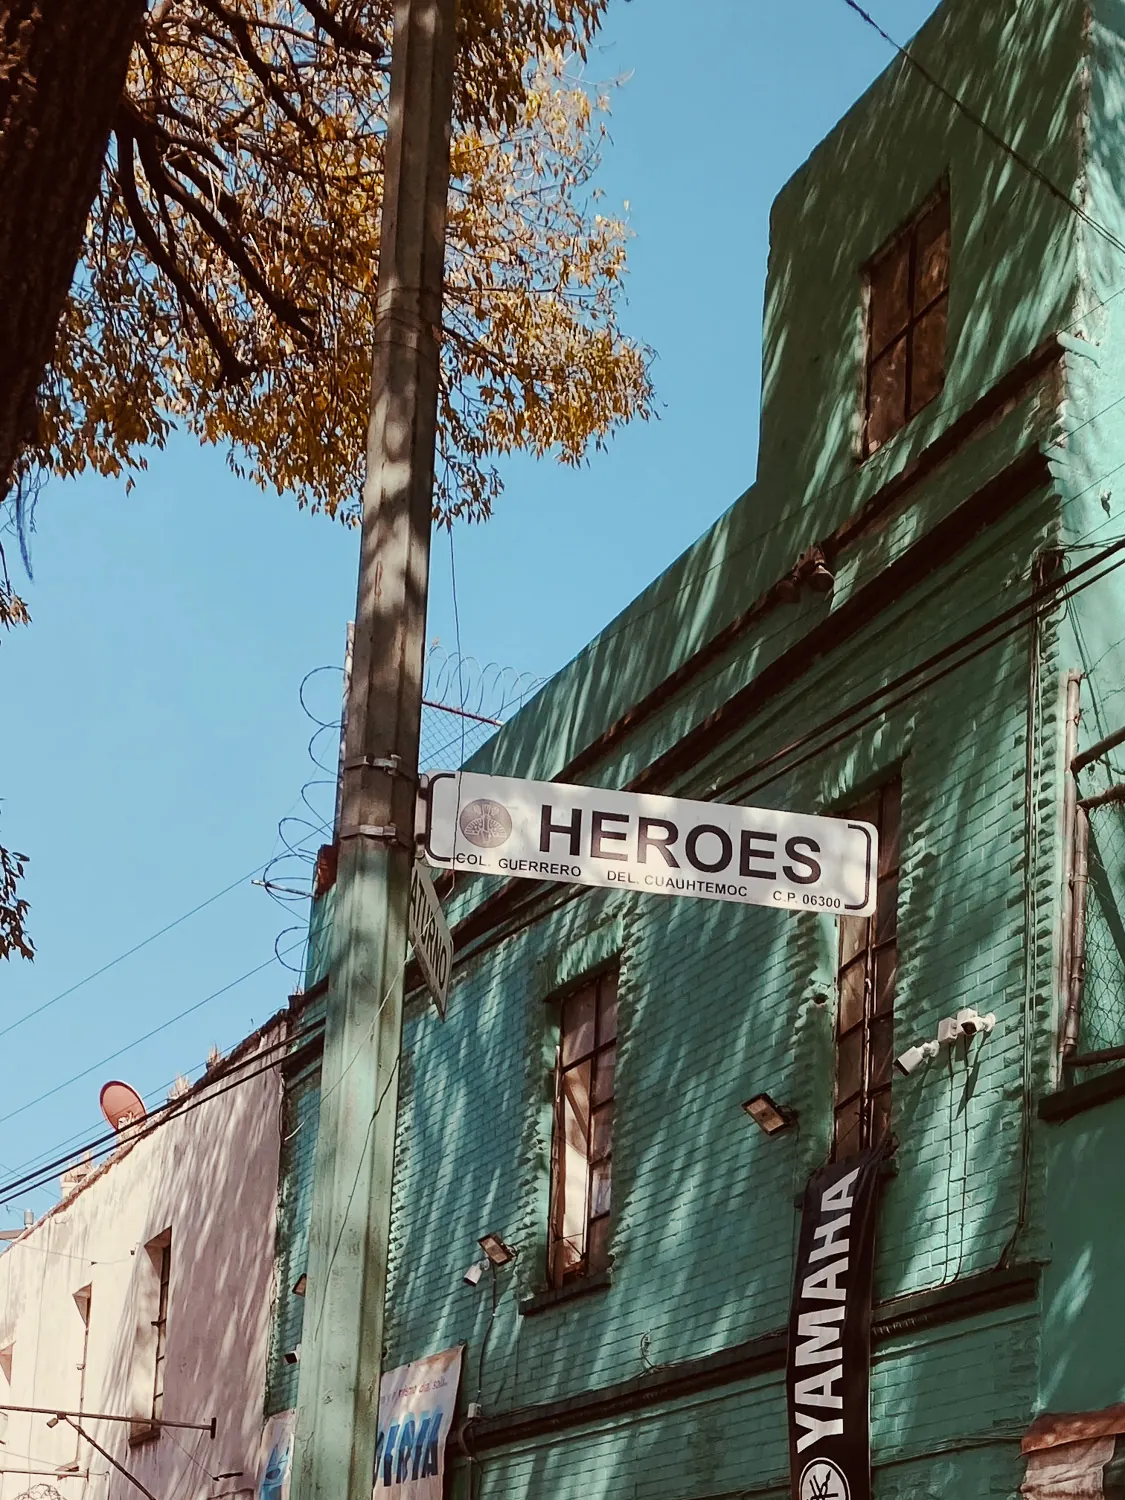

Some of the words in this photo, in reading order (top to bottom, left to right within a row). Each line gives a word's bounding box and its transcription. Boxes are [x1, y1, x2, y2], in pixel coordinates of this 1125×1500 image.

[456, 853, 490, 866] COL.
[498, 858, 581, 877] GUERRERO
[607, 870, 639, 884] DEL.
[645, 874, 747, 897] CUAUHTEMOC
[773, 890, 798, 903] C.P.
[803, 894, 841, 908] 06300
[539, 805, 822, 885] HEROES
[411, 869, 446, 990] ATURNO
[795, 1166, 860, 1454] YAMAHA
